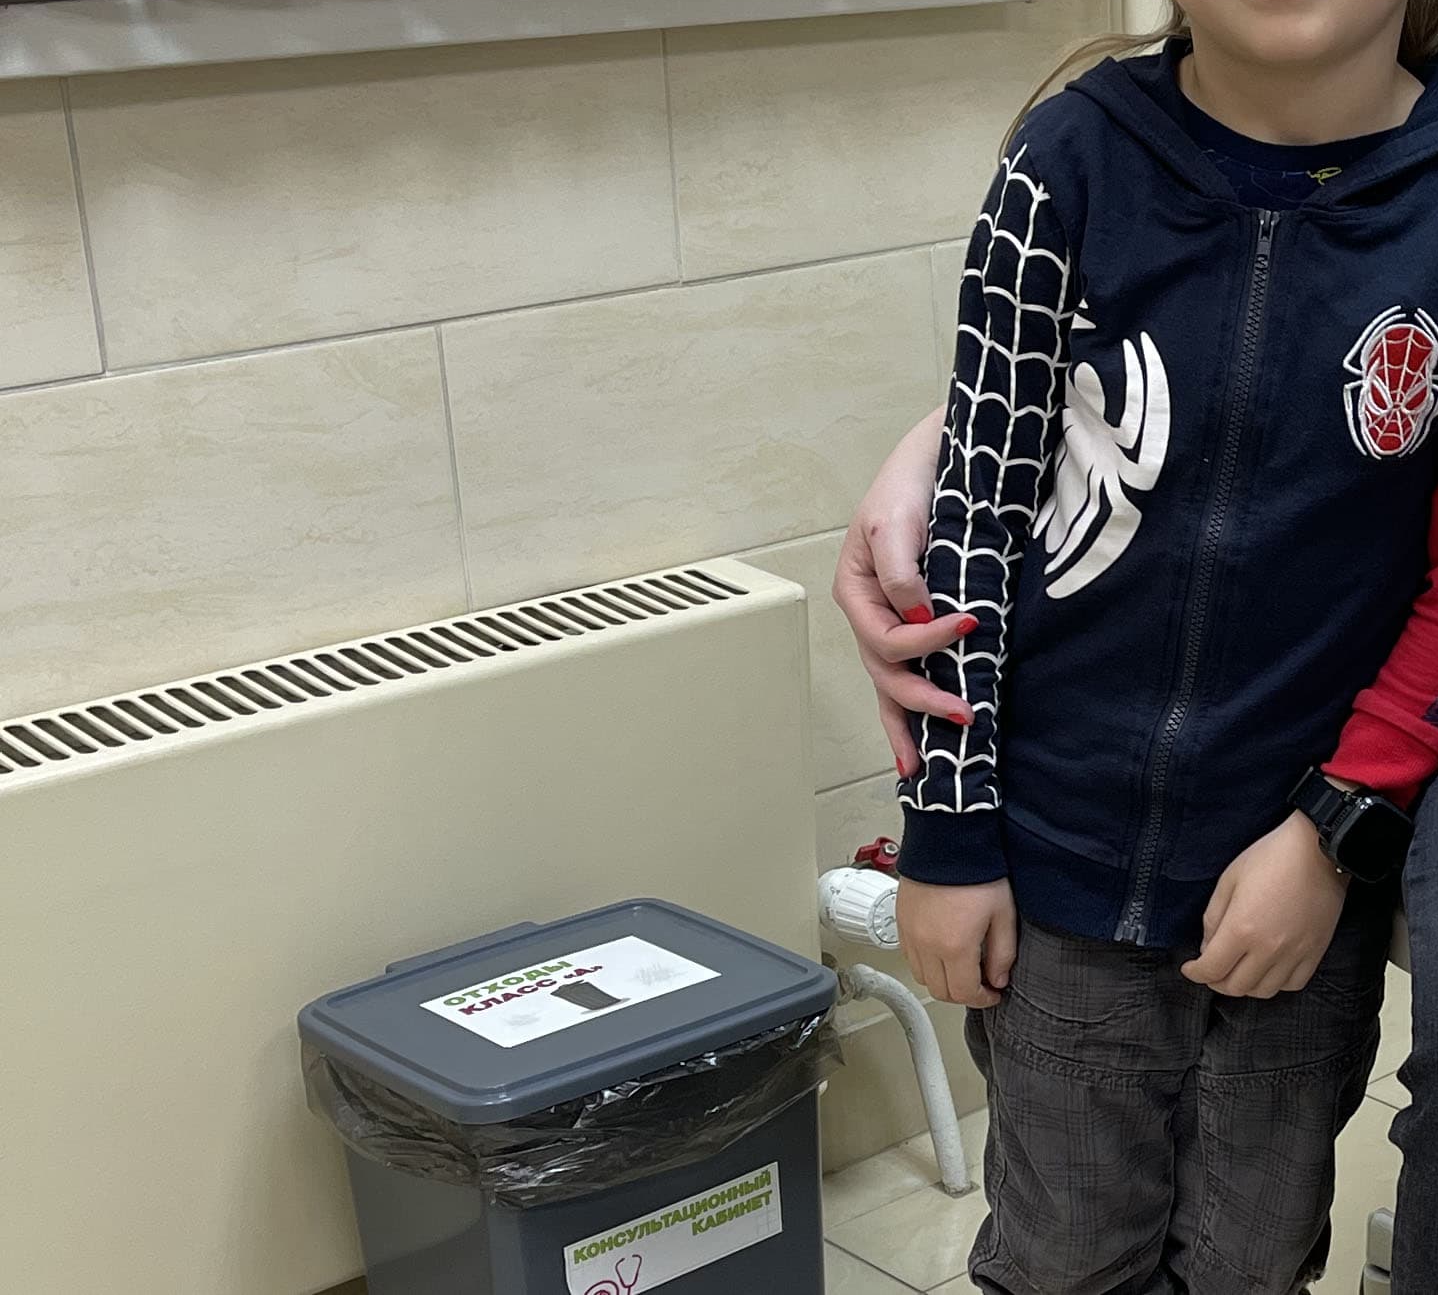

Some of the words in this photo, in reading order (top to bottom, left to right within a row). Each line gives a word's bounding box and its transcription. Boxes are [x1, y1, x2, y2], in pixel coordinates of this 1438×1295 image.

[443, 960, 574, 1006] ОТХОДЫ
[458, 979, 558, 1016] КЛАСС
[573, 1170, 772, 1264] КОНСУЛЬТАЦИОННЫЙ
[691, 1190, 773, 1236] КАБИНЕТ
